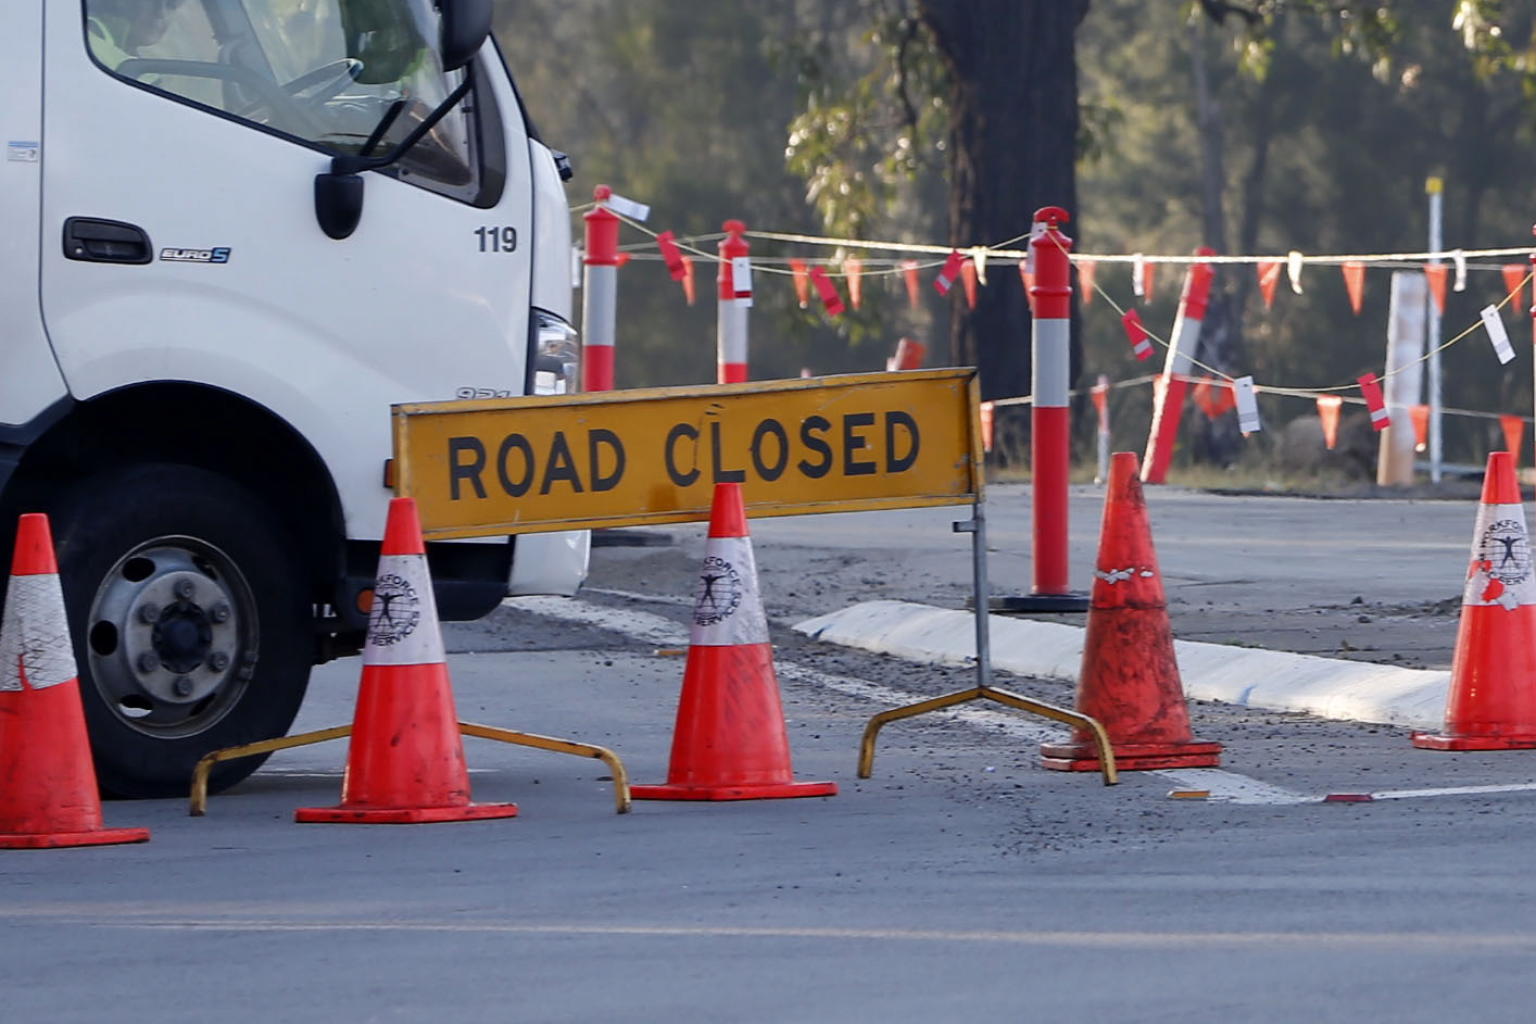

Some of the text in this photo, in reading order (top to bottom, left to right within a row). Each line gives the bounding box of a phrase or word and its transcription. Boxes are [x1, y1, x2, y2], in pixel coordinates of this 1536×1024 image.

[475, 227, 516, 252] 119
[448, 411, 920, 500] ROAD CLOSED
